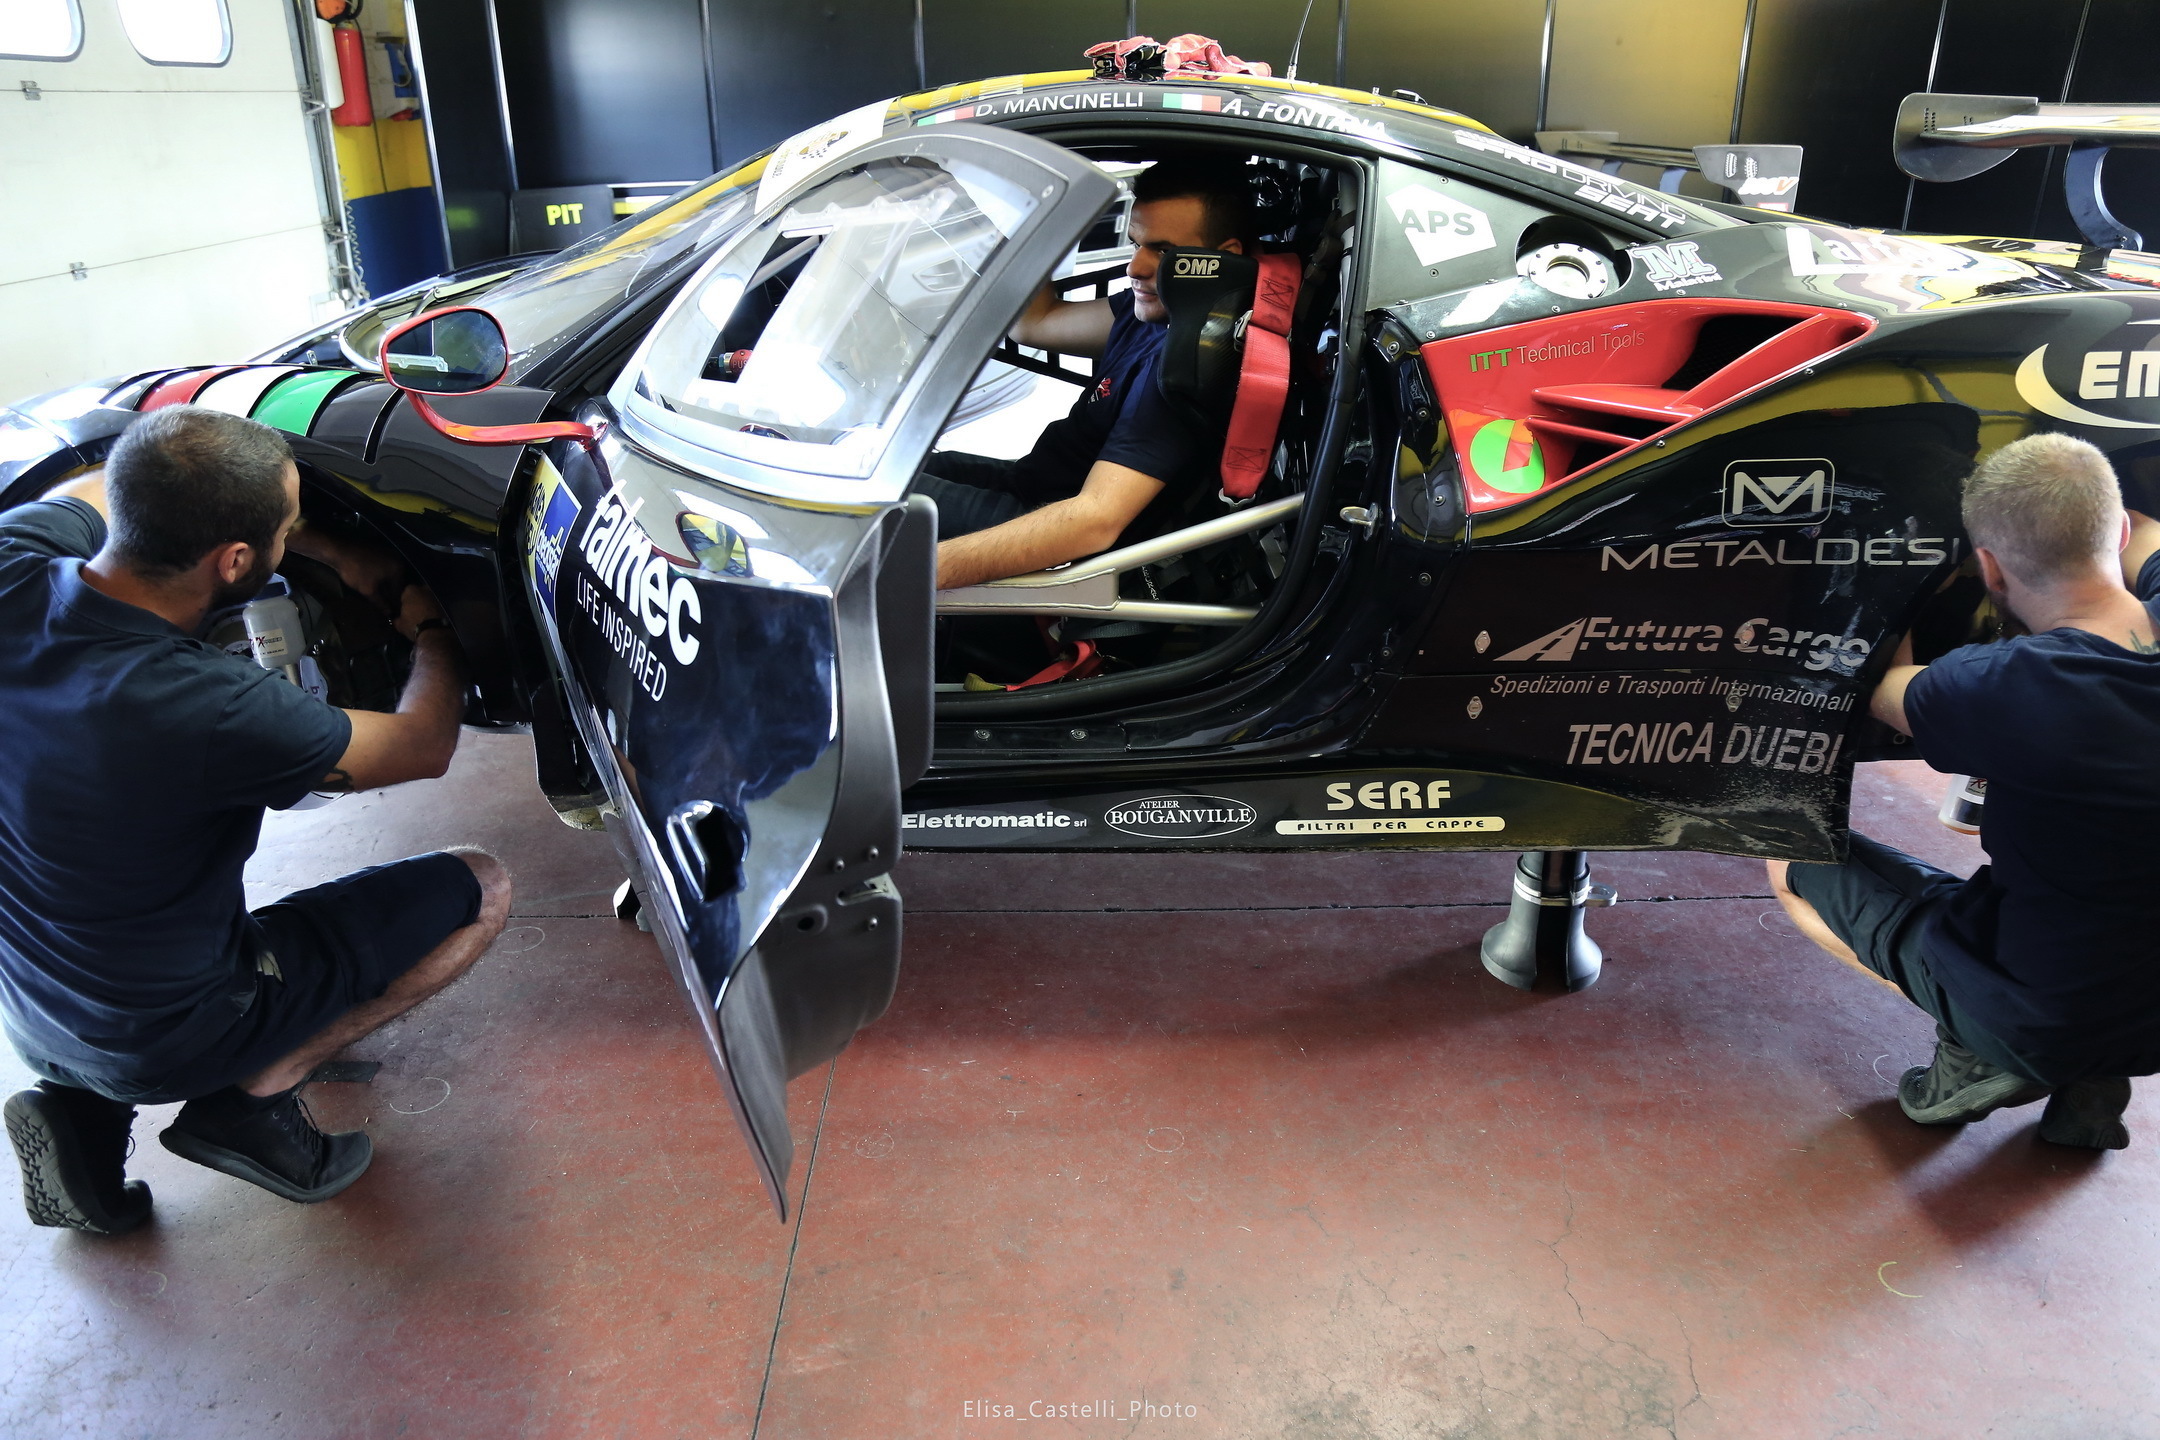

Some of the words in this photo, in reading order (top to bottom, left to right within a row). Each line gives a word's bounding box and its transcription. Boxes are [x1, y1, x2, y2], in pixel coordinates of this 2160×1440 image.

[975, 103, 998, 117] D.
[1003, 92, 1144, 115] MANCINELLI
[1221, 98, 1250, 117] A.
[545, 202, 584, 226] PIT
[1575, 184, 1686, 230] SEAT
[1401, 209, 1475, 236] APS
[1174, 257, 1220, 275] OMP
[1470, 348, 1512, 373] ITT
[1516, 336, 1595, 364] Technical
[1600, 330, 1645, 351] Tools
[576, 571, 601, 627] LIFE
[601, 601, 668, 703] INSPIRED
[1579, 616, 1724, 652] Futura
[1733, 617, 1871, 671] Cargo
[1490, 675, 1595, 698] Spedizioni
[1597, 679, 1611, 694] e
[1617, 675, 1707, 699] Trasporti
[1709, 675, 1857, 713] Internazionali
[1566, 721, 1714, 766] TECNICA
[1721, 722, 1845, 777] DUEBI
[1139, 800, 1181, 810] ATELIER
[1326, 779, 1452, 811] SERF
[901, 811, 1071, 829] Elettromatic
[1073, 818, 1087, 828] srl
[1110, 807, 1252, 825] BOUGANVILLE
[1297, 822, 1355, 831] FILTRI
[1372, 821, 1407, 830] PER
[1425, 820, 1485, 829] CAPPE
